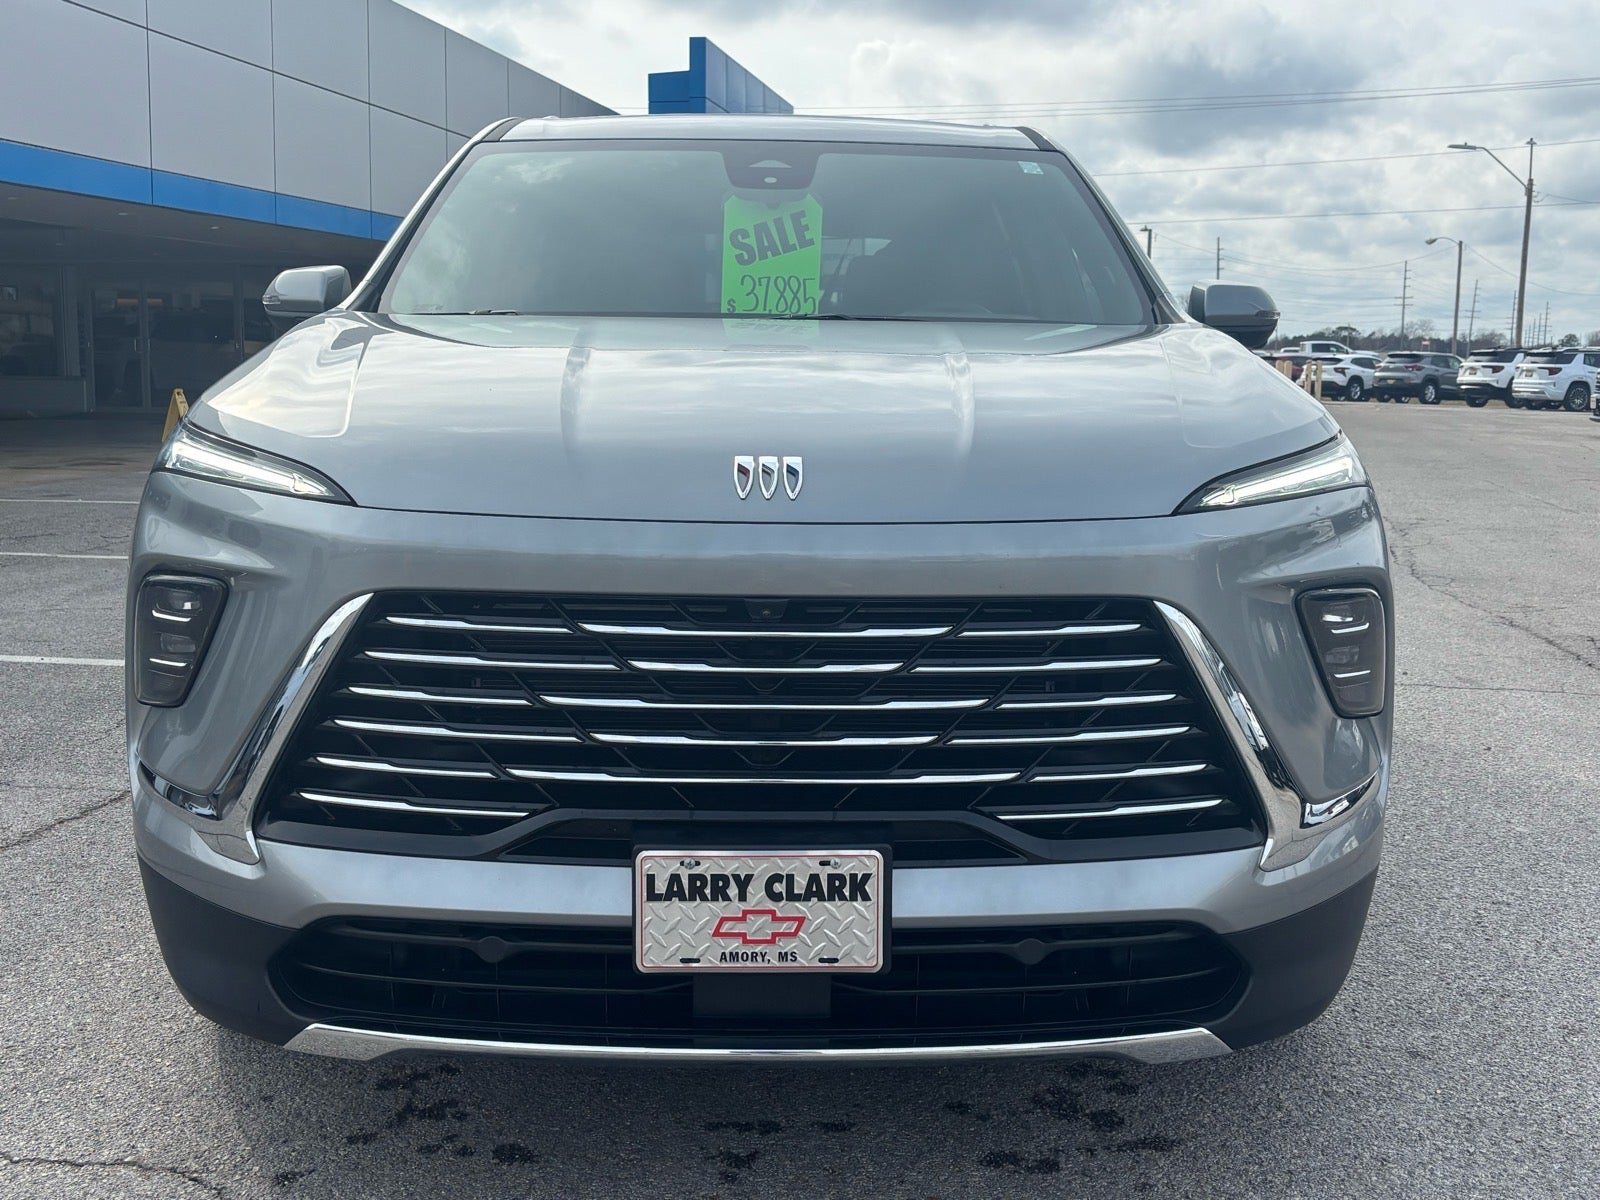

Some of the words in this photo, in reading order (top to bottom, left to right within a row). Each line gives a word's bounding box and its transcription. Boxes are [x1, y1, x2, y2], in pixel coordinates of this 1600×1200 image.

[729, 210, 815, 266] SALE
[646, 873, 753, 902] LARRY
[764, 873, 872, 902] CLARK
[719, 951, 771, 964] AMORY,
[778, 951, 798, 962] MS
